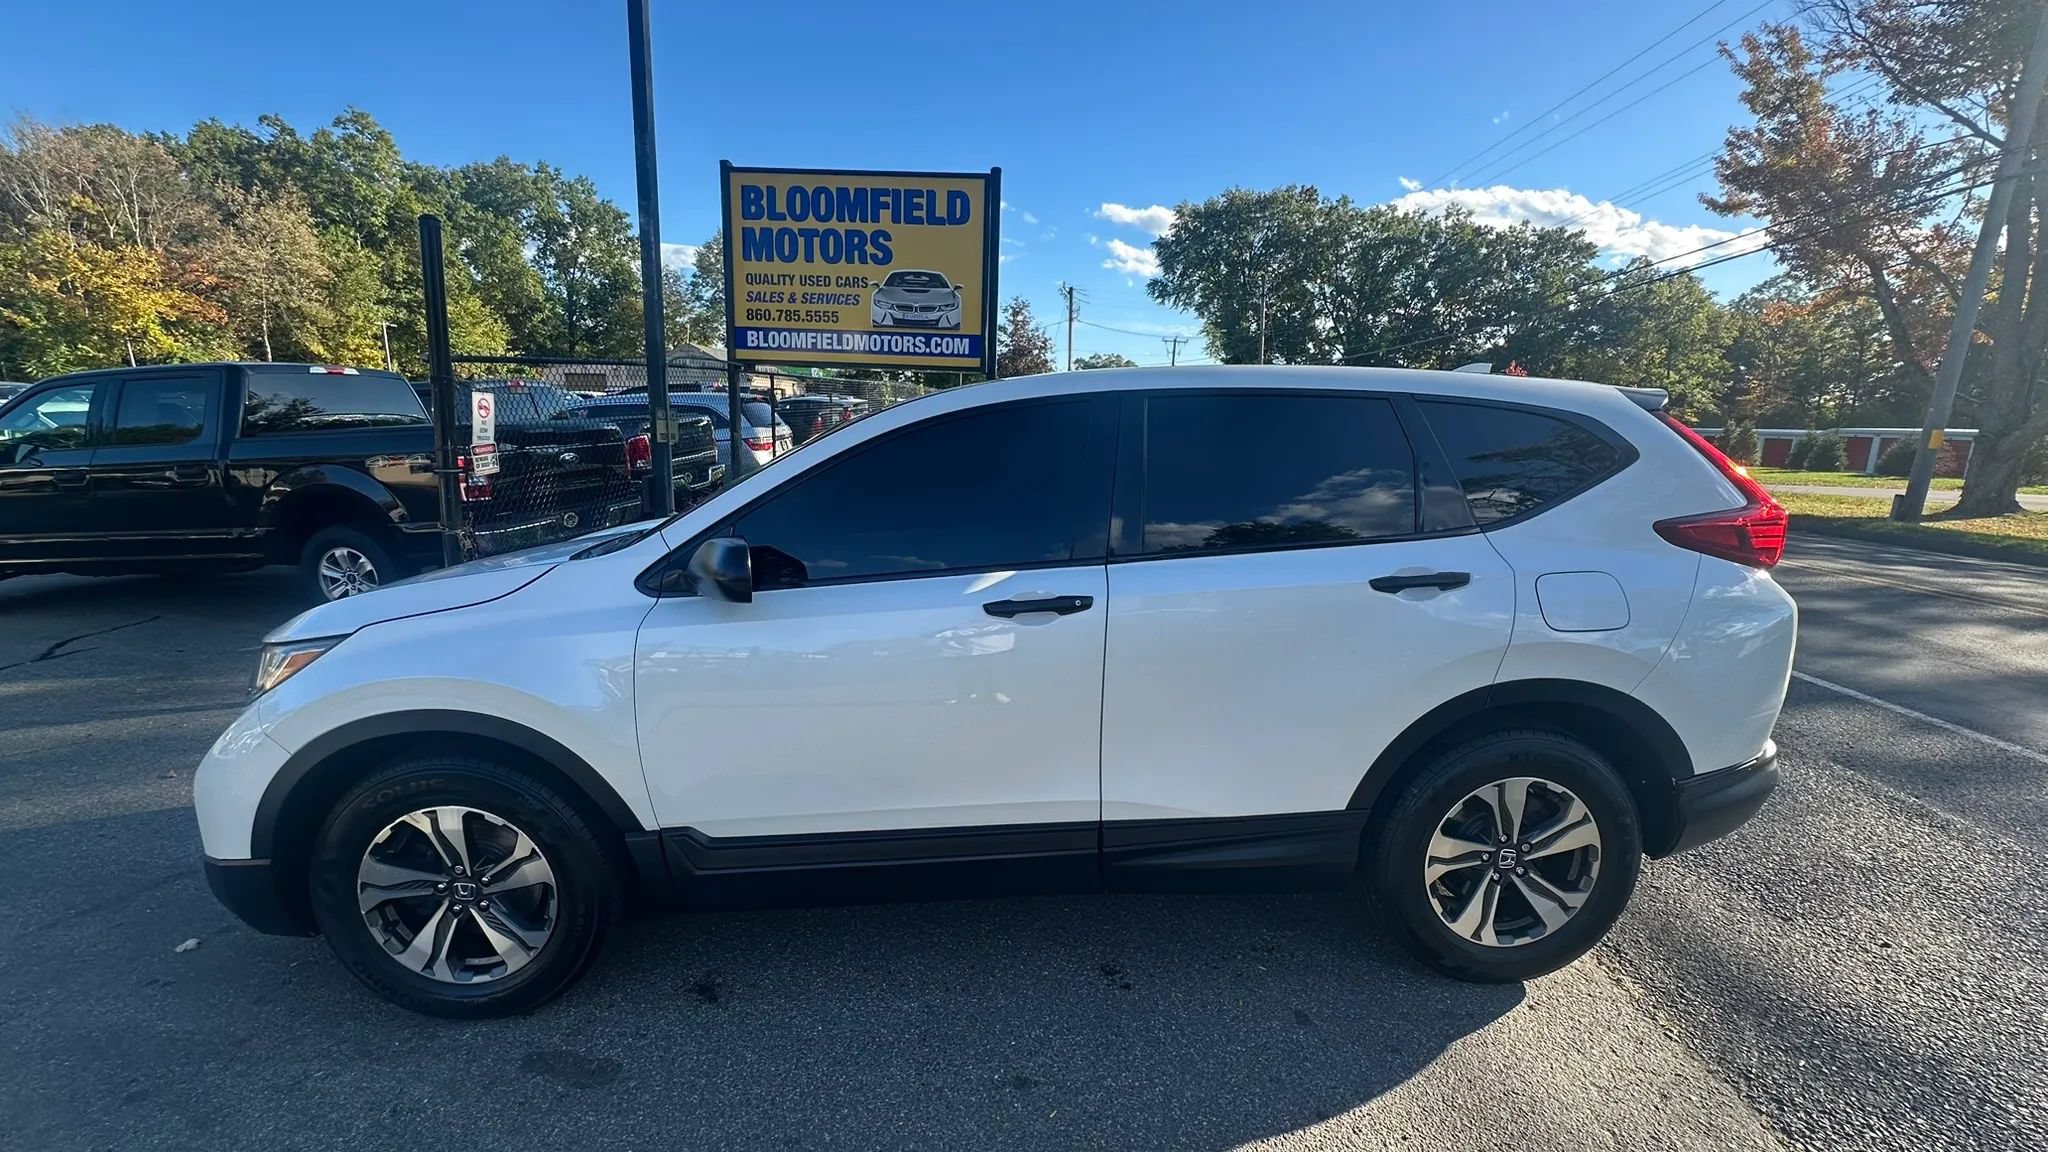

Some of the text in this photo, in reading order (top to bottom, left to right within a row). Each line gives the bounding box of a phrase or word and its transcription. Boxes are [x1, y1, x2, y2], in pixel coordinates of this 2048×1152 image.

[740, 184, 971, 226] BLOOMFIELD
[741, 226, 893, 266] MOTORS
[745, 273, 869, 289] QUALITY USED CARS
[745, 291, 860, 306] SALES & SERVICES
[745, 308, 840, 324] 860.785.5555
[747, 330, 970, 355] BLOOMFIELDMOTORS.COM
